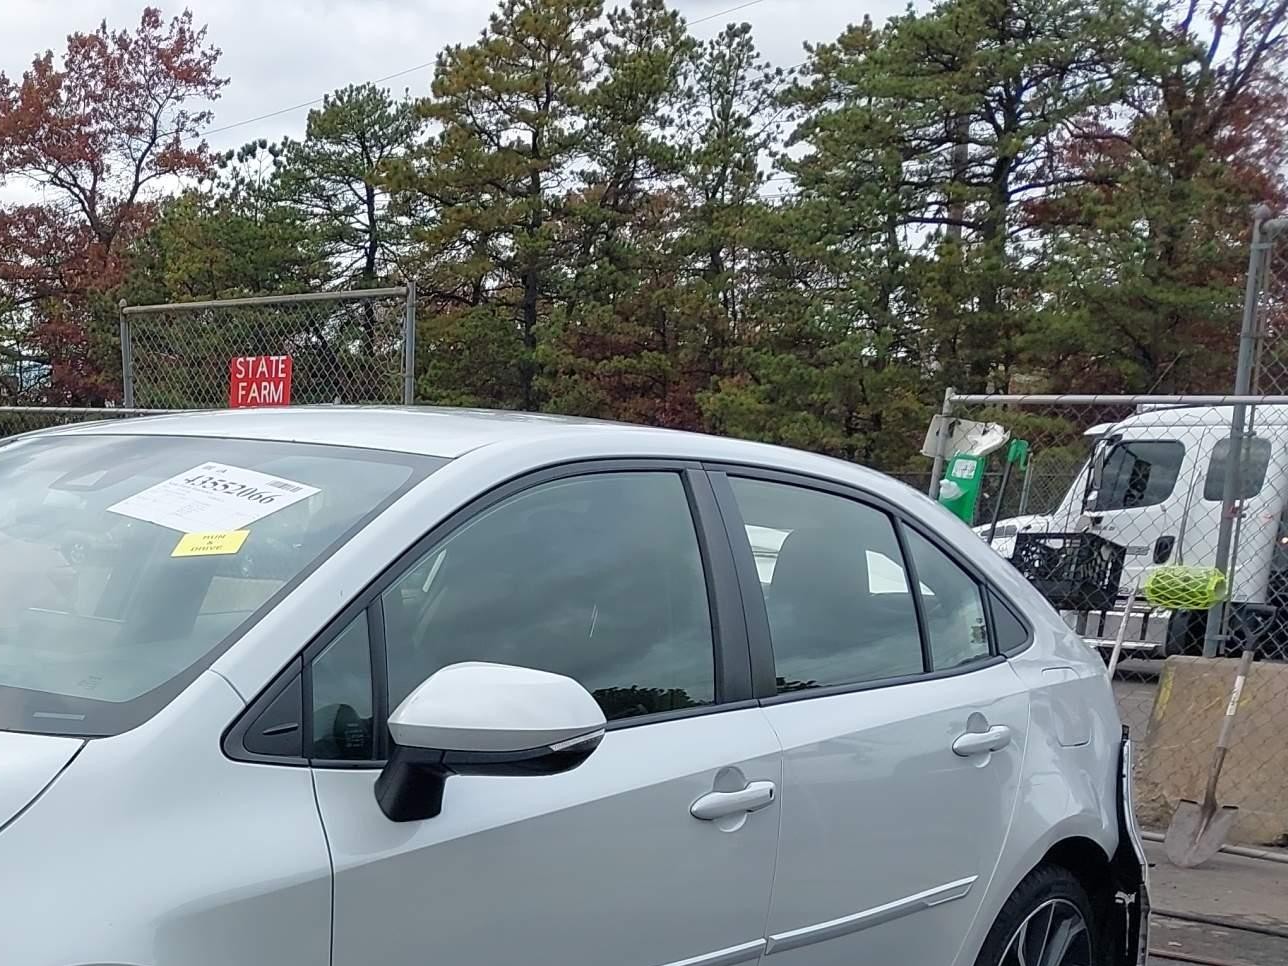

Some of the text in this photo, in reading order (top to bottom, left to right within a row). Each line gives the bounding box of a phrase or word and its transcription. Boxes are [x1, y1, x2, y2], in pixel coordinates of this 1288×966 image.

[235, 355, 287, 379] STATE
[238, 381, 284, 404] FARM
[184, 474, 282, 505] 43552066
